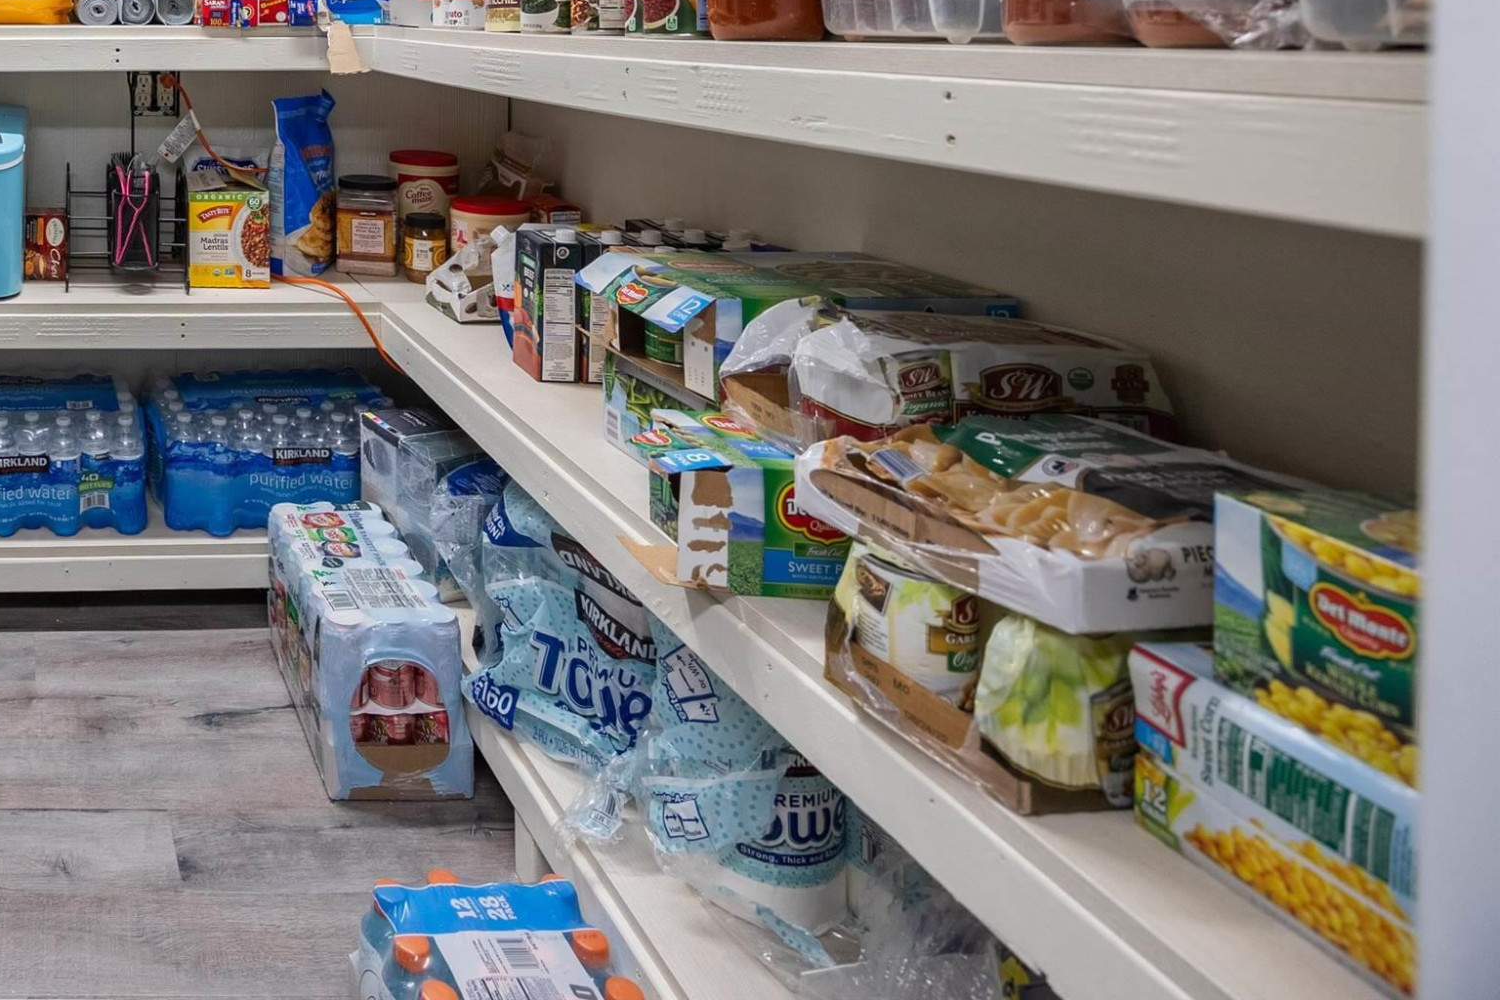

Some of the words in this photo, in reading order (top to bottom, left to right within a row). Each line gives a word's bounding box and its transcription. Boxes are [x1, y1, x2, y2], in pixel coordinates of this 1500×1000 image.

[200, 236, 229, 244] Madras
[203, 243, 229, 251] Lentils
[49, 248, 62, 279] Chai
[680, 297, 700, 315] 12
[275, 448, 330, 460] KIRKLAND
[249, 472, 306, 490] purified
[28, 487, 72, 500] water
[788, 562, 831, 575] SWEET
[1317, 593, 1345, 622] Del
[1347, 610, 1408, 649] Monte
[782, 855, 807, 865] Thick
